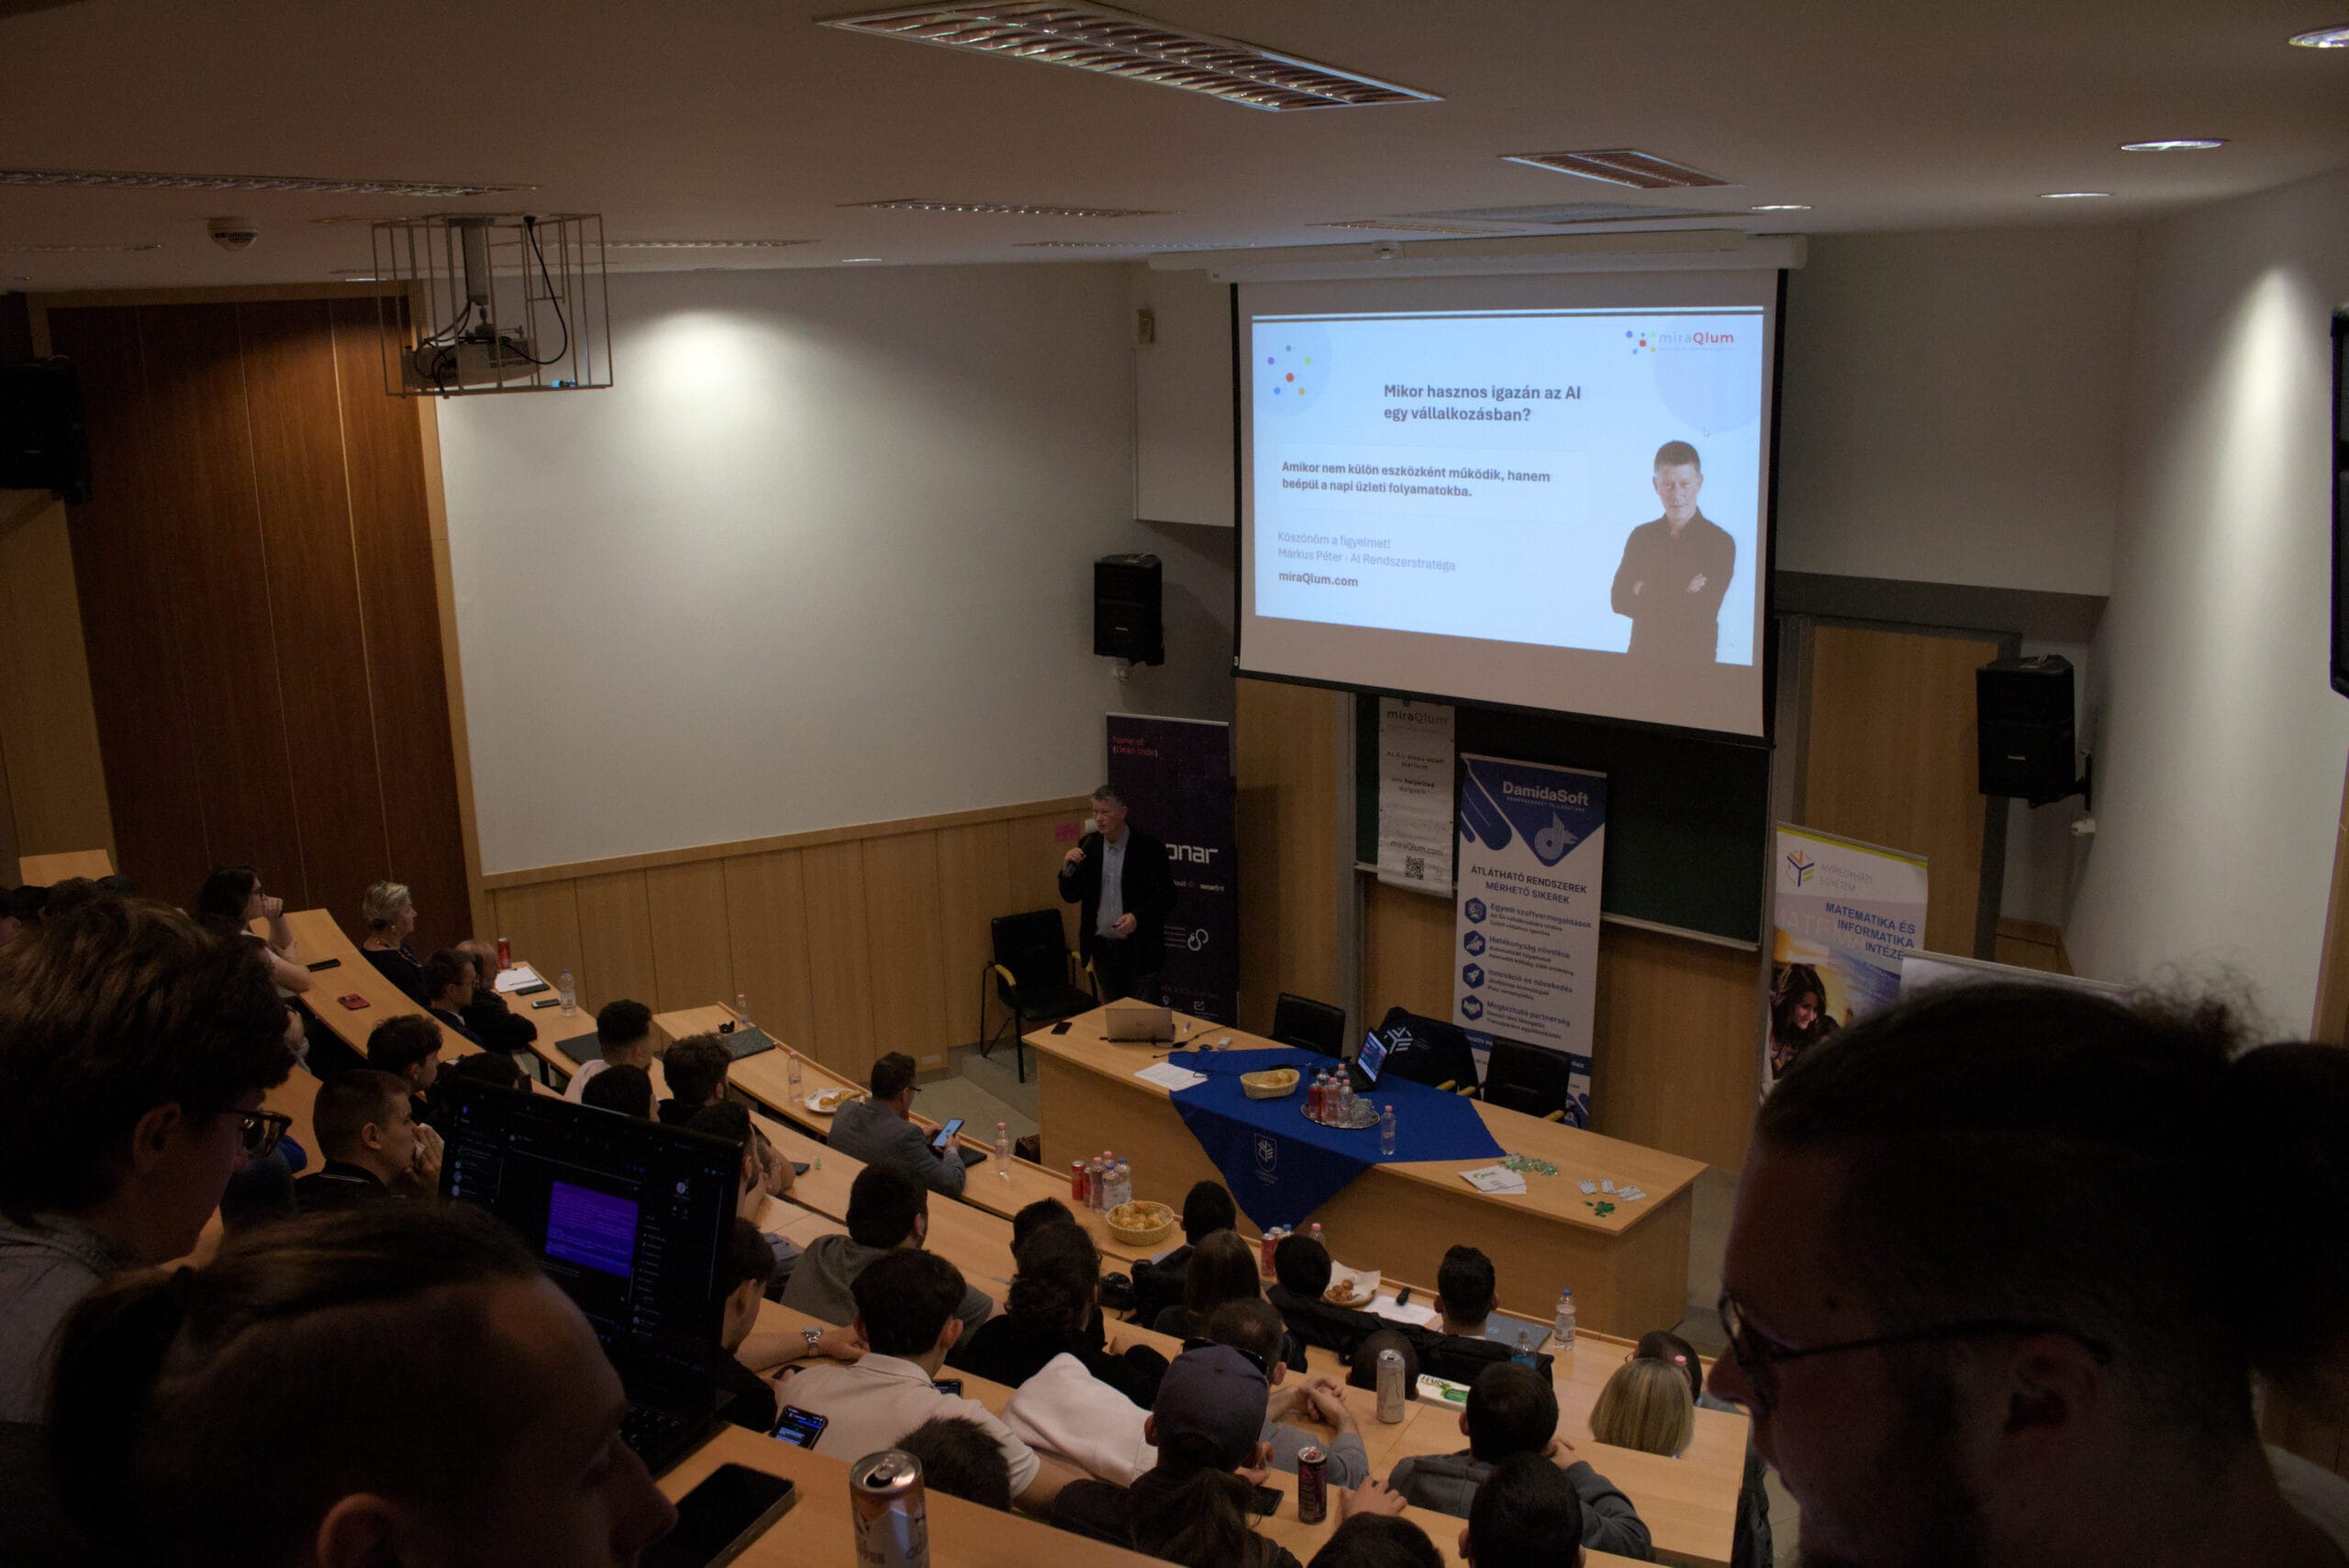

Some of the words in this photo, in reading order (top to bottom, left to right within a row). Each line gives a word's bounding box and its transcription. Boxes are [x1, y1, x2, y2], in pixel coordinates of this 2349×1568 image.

[1659, 331, 1734, 346] miraQlum
[1384, 384, 1423, 398] Mikor
[1427, 384, 1488, 400] hasznos
[1491, 384, 1541, 402] igazán
[1543, 387, 1562, 400] az
[1565, 385, 1581, 400] AI
[1384, 409, 1408, 422] egy
[1411, 406, 1531, 422] vállalkozásban?
[1282, 462, 1319, 473] Amikor
[1321, 464, 1346, 474] nem
[1348, 462, 1379, 476] külön
[1381, 465, 1446, 478] eszközként
[1449, 466, 1505, 482] működik,
[1508, 469, 1551, 483] hanem
[1282, 478, 1319, 493] beépül
[1320, 482, 1328, 490] a
[1330, 480, 1353, 494] napi
[1355, 479, 1386, 493] üzleti
[1388, 482, 1473, 497] folyamatokba.
[1277, 531, 1330, 545] Köszönöm
[1331, 538, 1338, 546] a
[1340, 536, 1391, 550] figyelmet!
[1277, 547, 1314, 560] Márkus
[1316, 550, 1342, 562] Péter
[1363, 553, 1456, 573] Rendszerstratéga
[1278, 571, 1359, 587] miraQlum.com
[1386, 709, 1447, 725] miraQlum
[1502, 780, 1589, 806] DamidaSoft
[1164, 843, 1219, 864] onar
[1471, 865, 1525, 883] ÁTLÁTHATÓ
[1526, 875, 1588, 895] RENDSZEREK
[1531, 890, 1571, 905] SIKEREK
[1825, 902, 1897, 931] MATEMATIKA
[1898, 920, 1916, 934] ÉS
[1837, 919, 1915, 949] INFORMATIKA
[1865, 941, 1905, 961] INTÉZE
